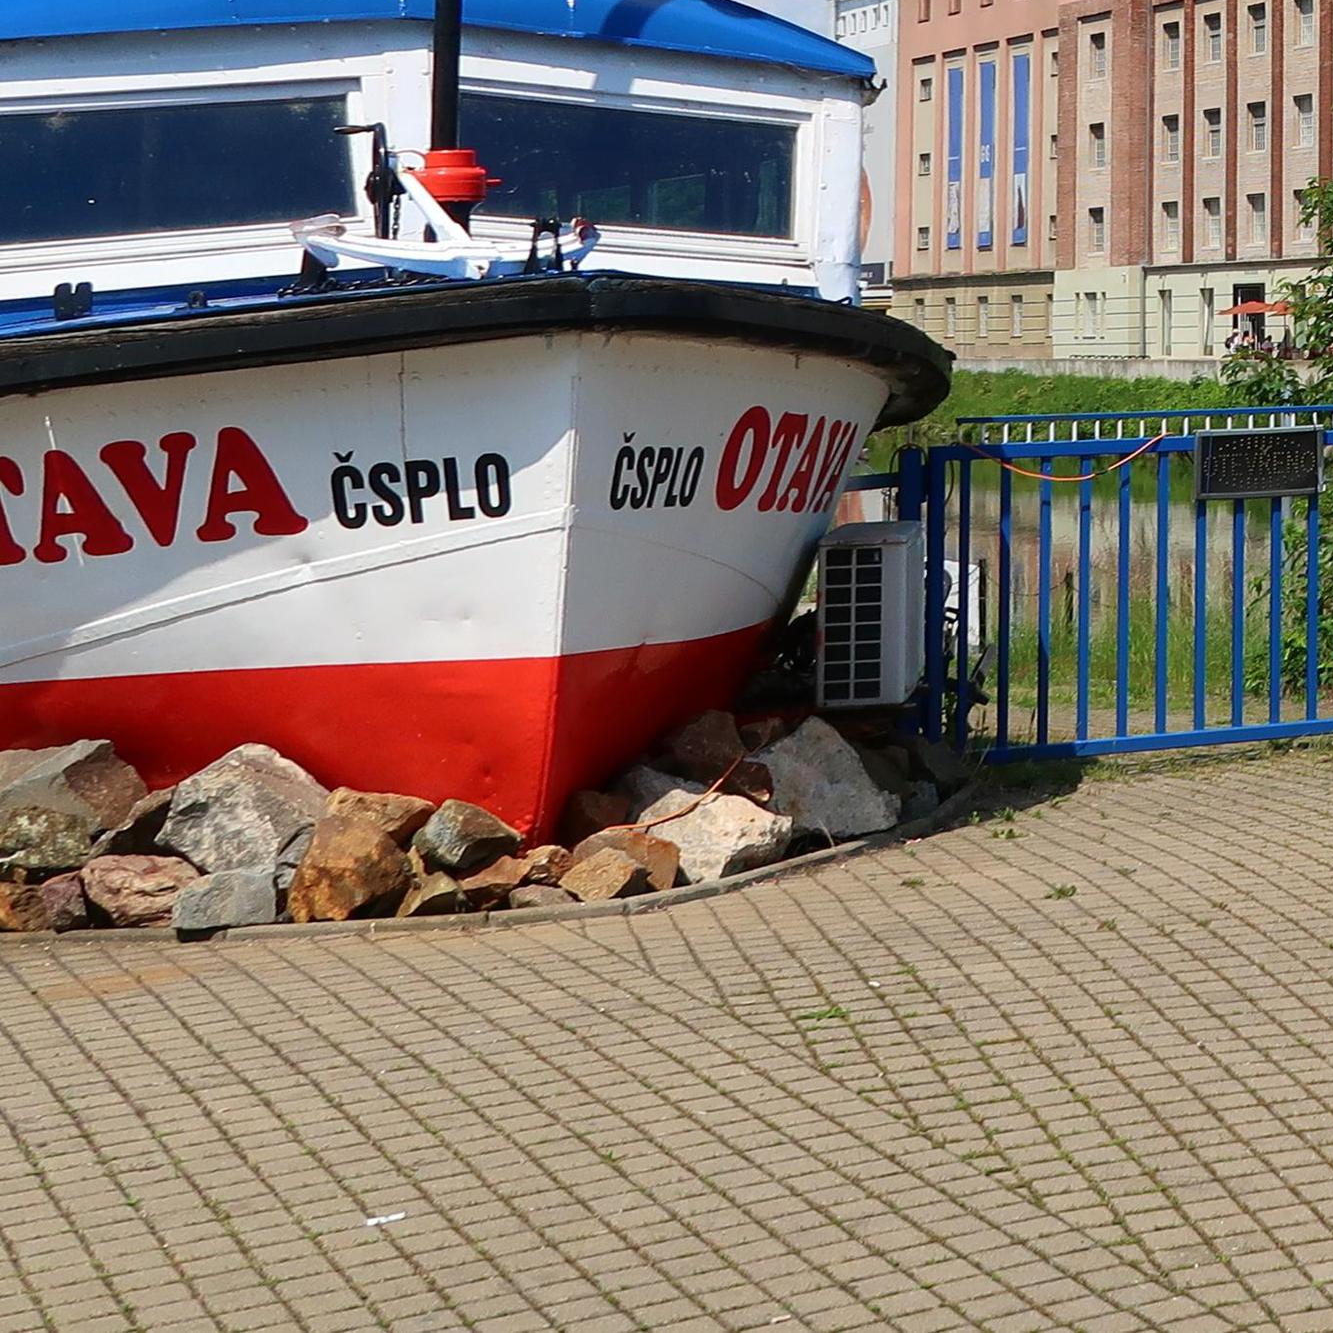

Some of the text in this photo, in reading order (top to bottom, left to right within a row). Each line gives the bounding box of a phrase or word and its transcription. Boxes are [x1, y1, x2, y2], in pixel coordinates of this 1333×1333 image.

[331, 451, 510, 529] ČSPLO
[610, 405, 858, 513] ČSPLO OTAVA
